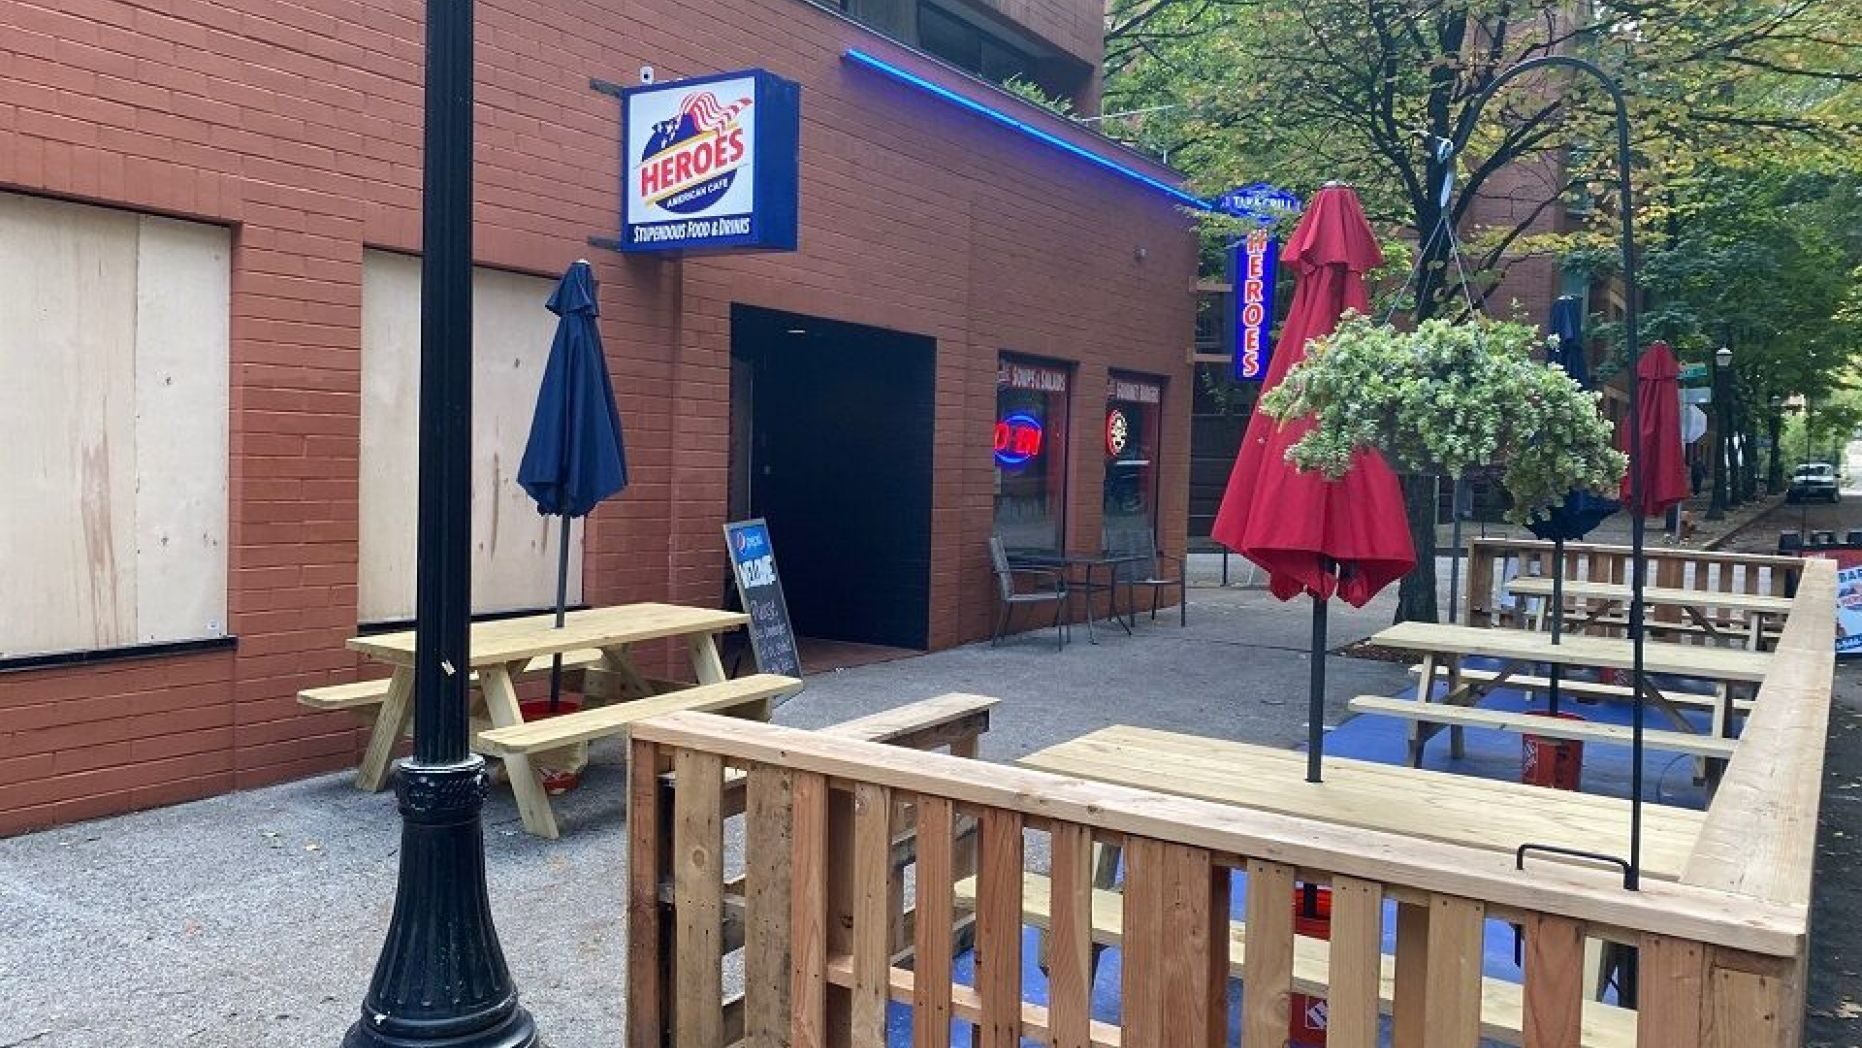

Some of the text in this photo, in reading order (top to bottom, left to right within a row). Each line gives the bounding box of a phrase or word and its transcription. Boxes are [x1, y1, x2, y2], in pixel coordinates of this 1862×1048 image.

[641, 128, 744, 197] HEROES
[667, 178, 728, 208] AMERICAN CAFE
[634, 217, 750, 243] STUPENDOUS FOOD & DRINKS
[1243, 229, 1267, 378] HEROES
[994, 423, 1042, 456] OEN
[738, 555, 776, 589] WELCOME
